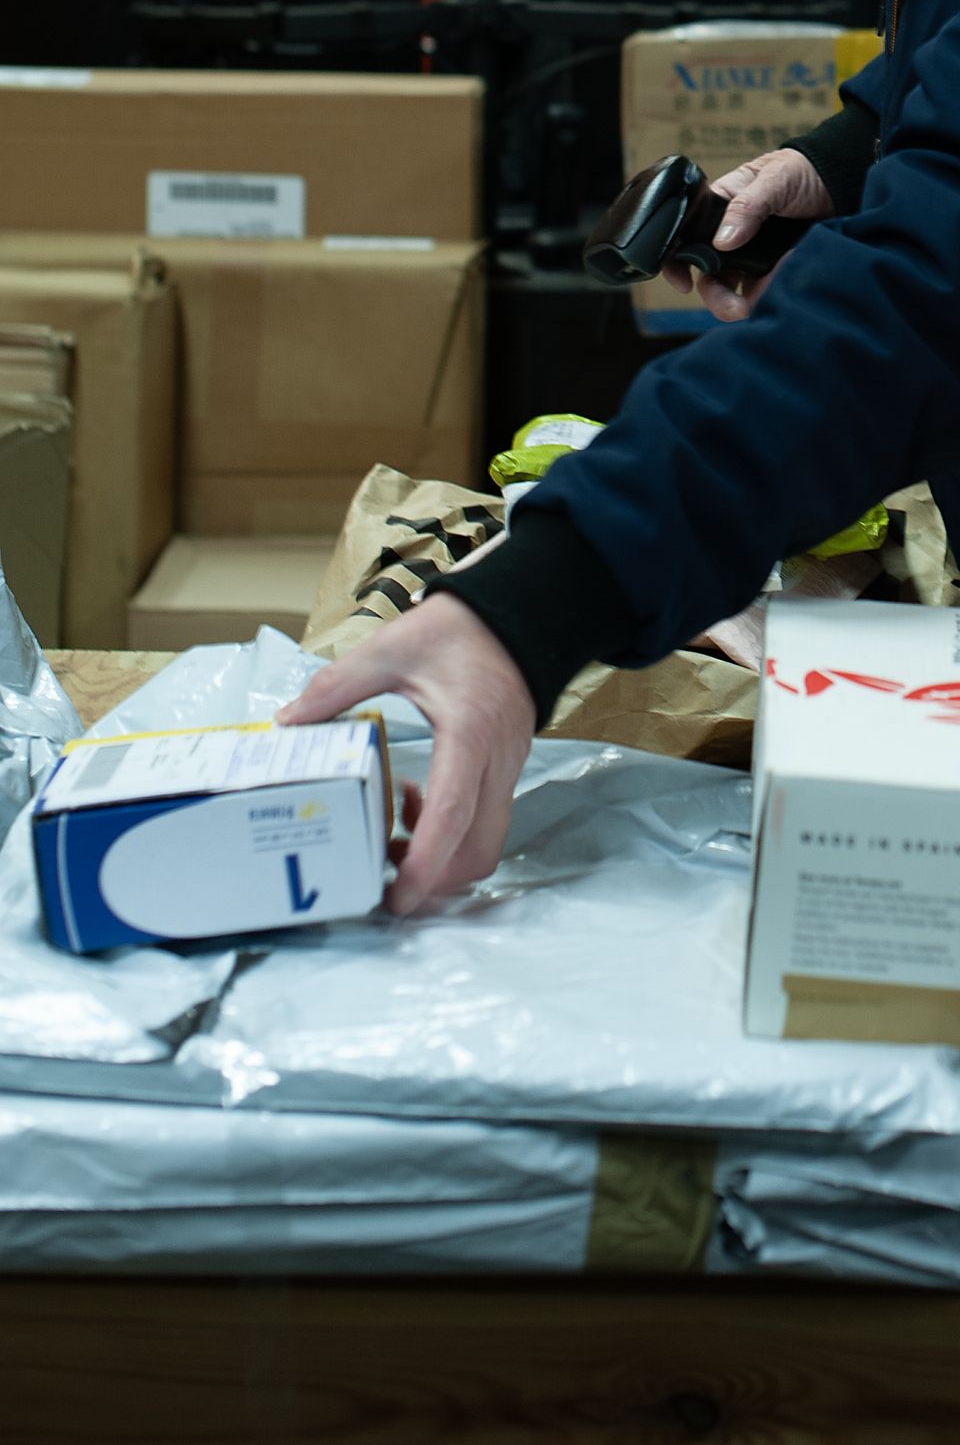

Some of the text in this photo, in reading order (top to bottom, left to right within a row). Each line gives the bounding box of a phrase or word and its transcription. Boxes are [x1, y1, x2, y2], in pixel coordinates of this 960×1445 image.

[800, 830, 857, 850] MADE
[867, 835, 890, 853] IN
[285, 853, 320, 913] 1
